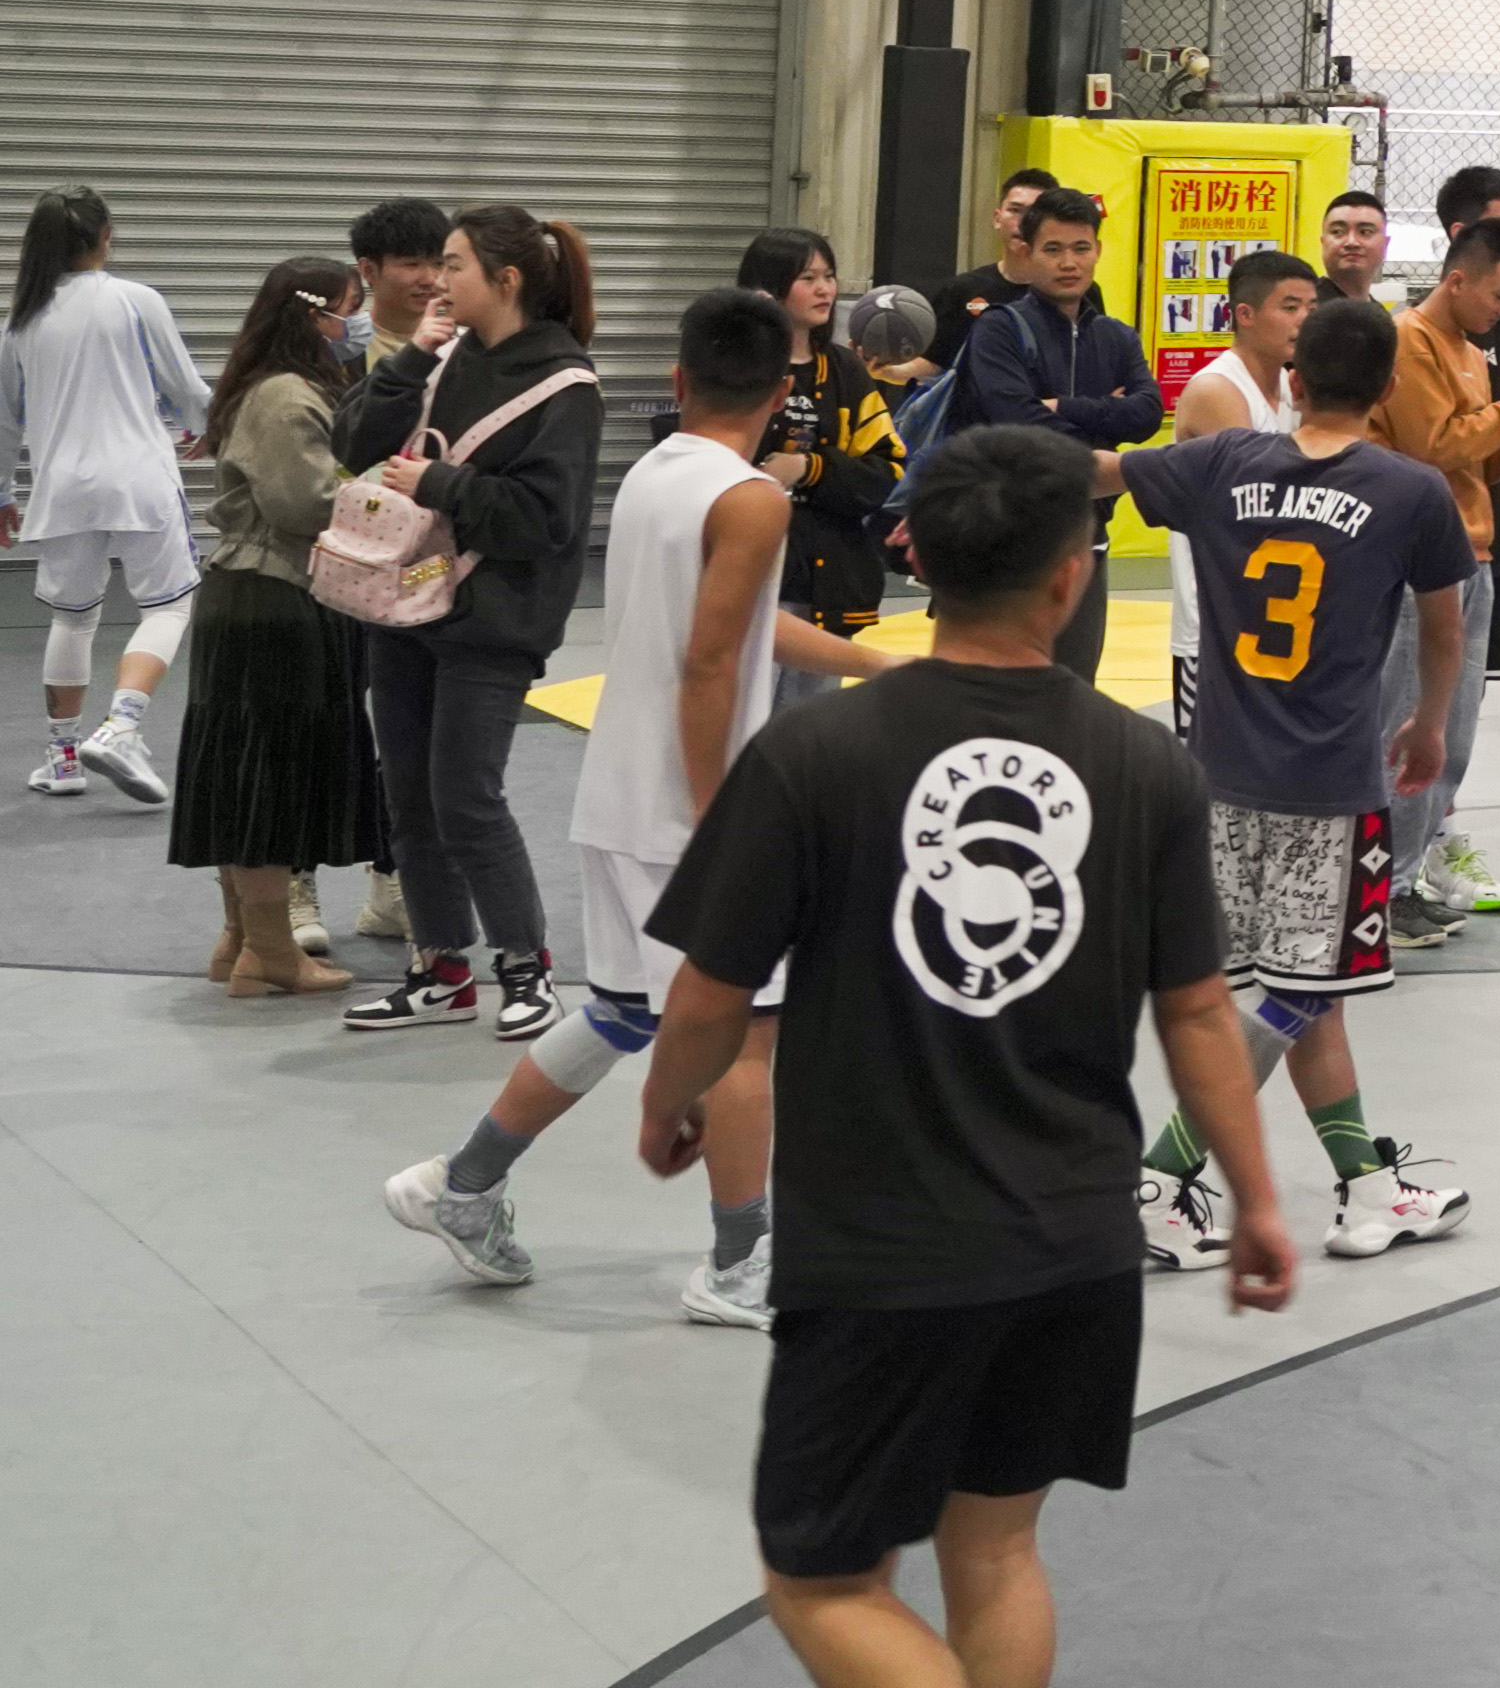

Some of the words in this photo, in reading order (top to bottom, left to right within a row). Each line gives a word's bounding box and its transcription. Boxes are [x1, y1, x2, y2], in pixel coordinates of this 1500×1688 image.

[1170, 178, 1277, 213] 消防栓
[1179, 216, 1268, 230] 消防栓的使用方法
[1231, 482, 1276, 520] THE
[1278, 485, 1373, 538] ANSWER
[1234, 538, 1325, 682] 3
[917, 753, 1073, 880] CREATORS
[959, 864, 1060, 996] UNITE
